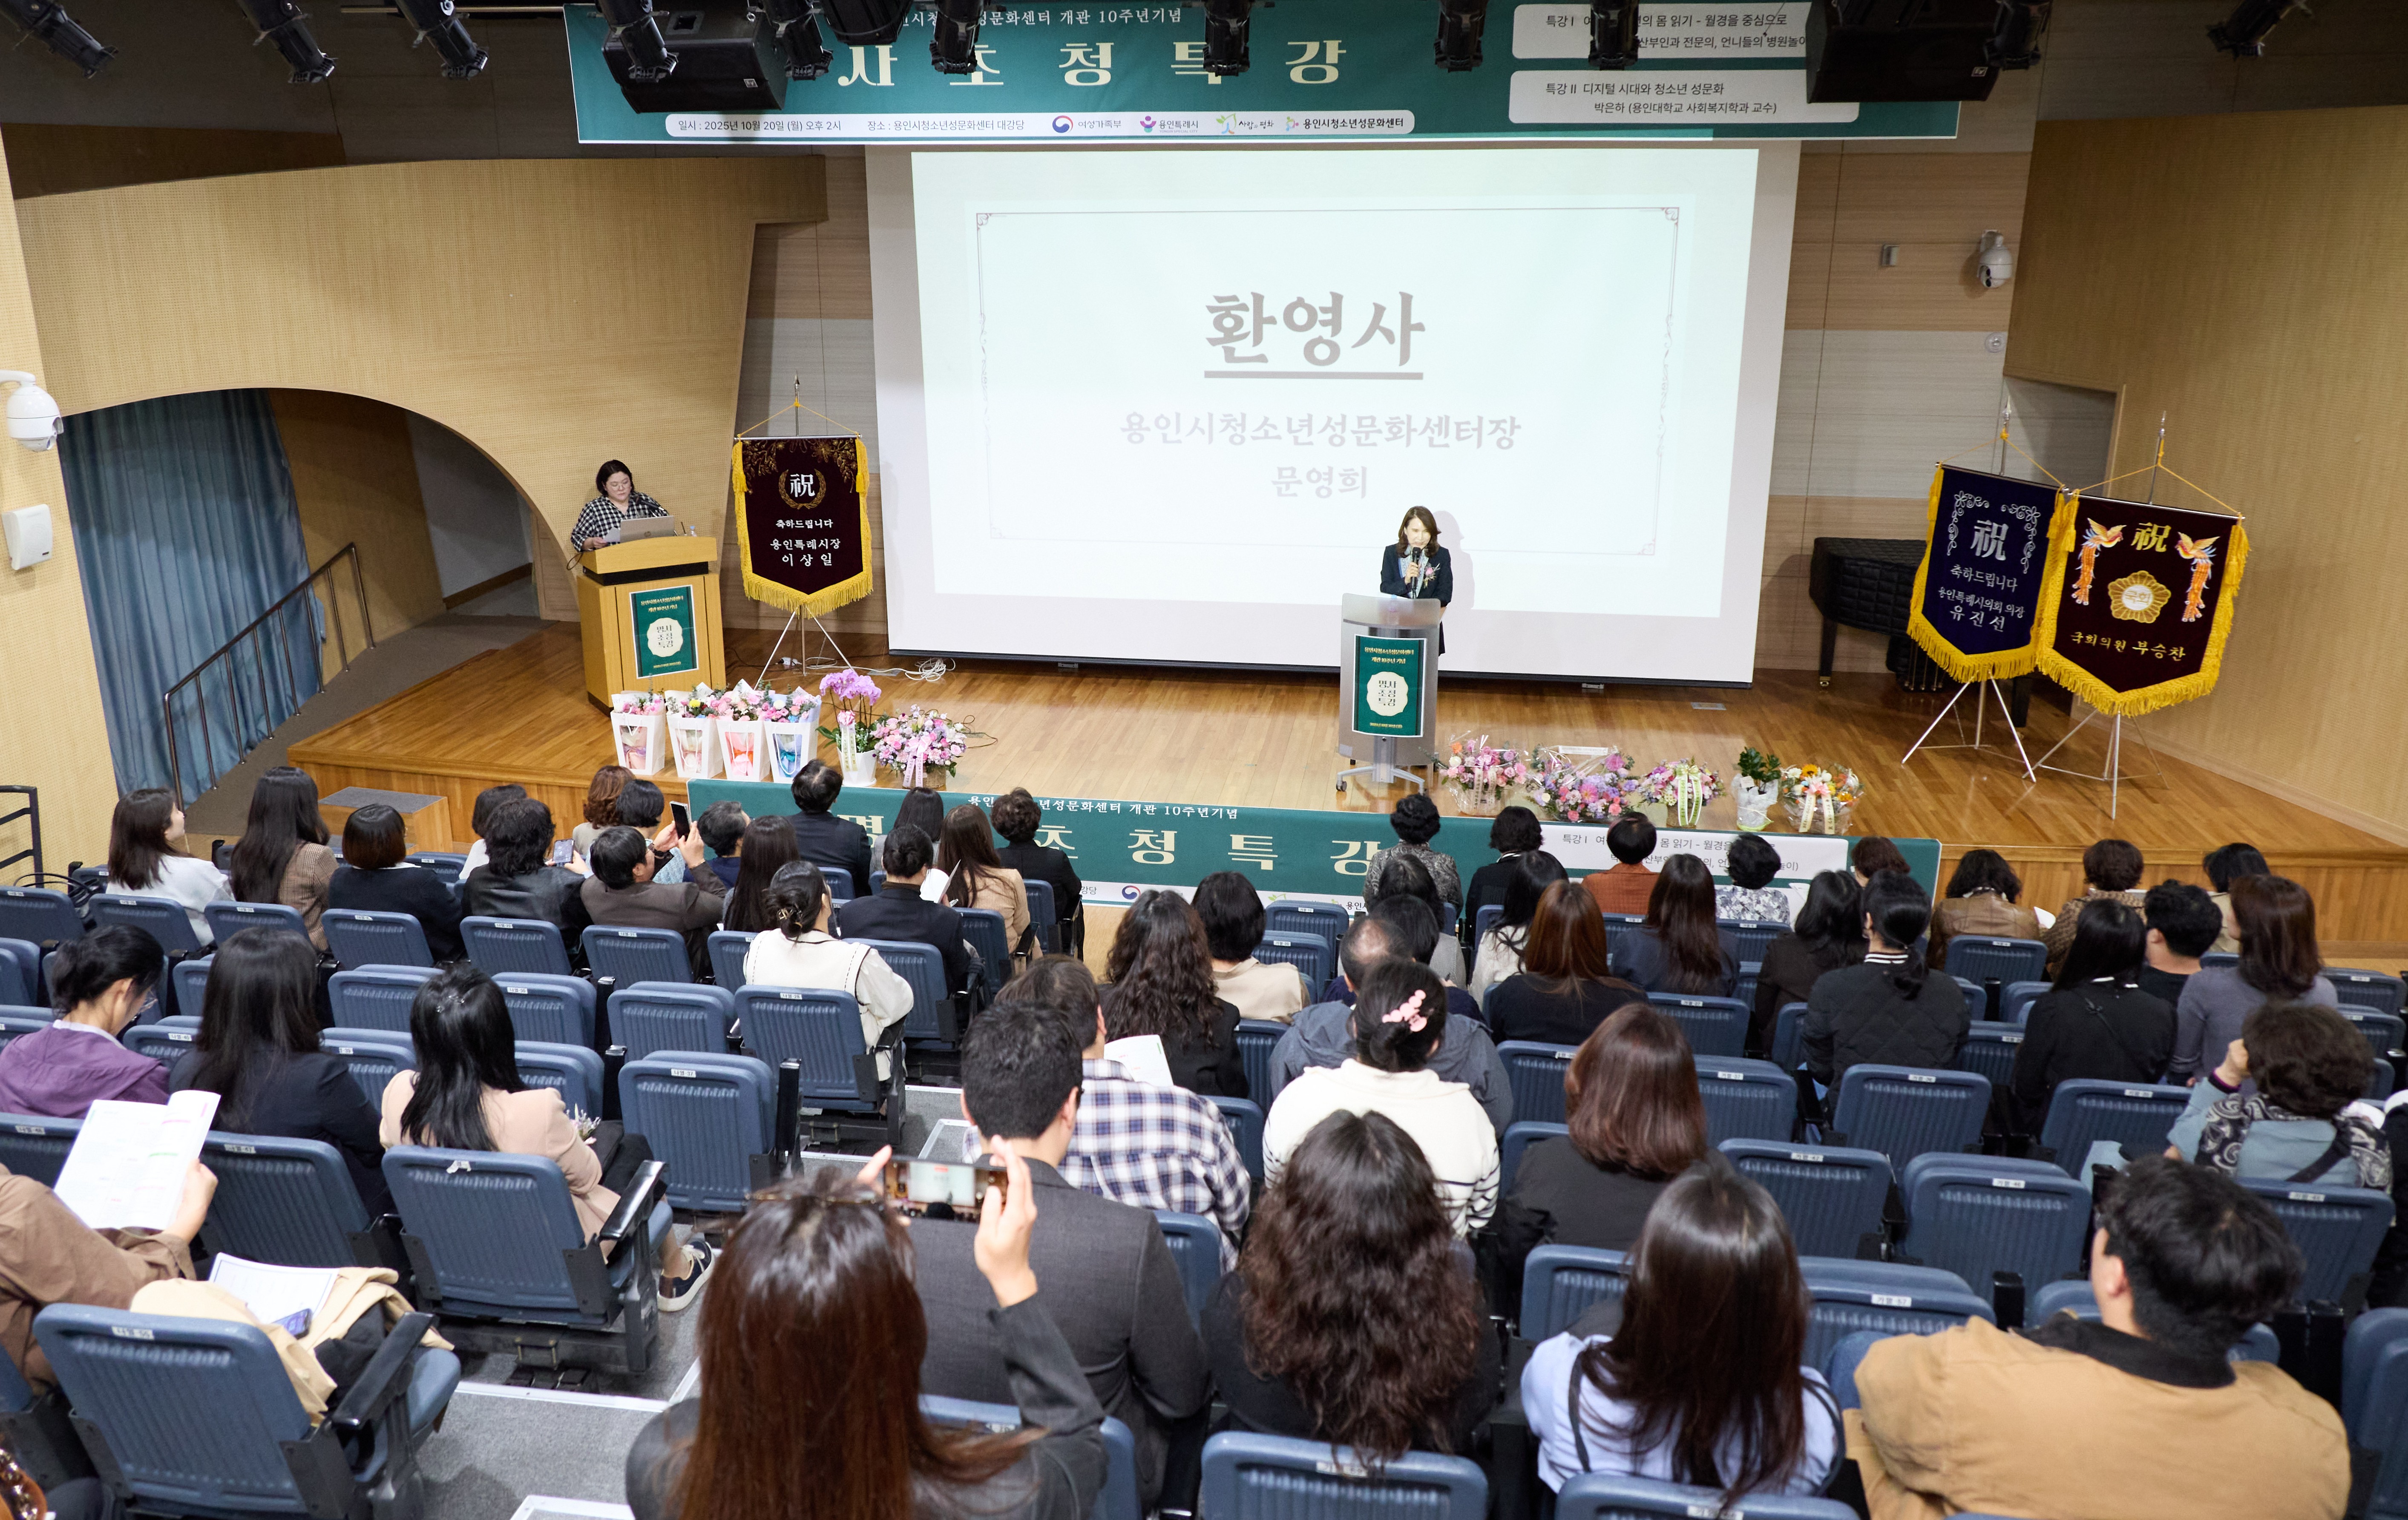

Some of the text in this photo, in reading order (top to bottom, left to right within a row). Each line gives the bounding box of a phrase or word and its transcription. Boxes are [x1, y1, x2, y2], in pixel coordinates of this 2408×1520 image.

[1060, 10, 1090, 25] 개관
[1099, 8, 1181, 23] 10주년기념
[1546, 15, 1567, 27] 특강
[1657, 15, 1667, 27] 몸
[1672, 15, 1692, 27] 읽기
[1705, 14, 1739, 27] 월경을
[1742, 14, 1787, 26] 중심으로
[1683, 37, 1717, 49] 전문의,
[1721, 37, 1763, 47] 언니들의
[1546, 83, 1567, 95] 특강
[1583, 83, 1615, 95] 디지털
[1619, 83, 1651, 95] 시대와
[1654, 83, 1686, 95] 청소년
[1691, 83, 1724, 95] 성문화
[1595, 103, 1777, 114] 박은하 (용인대학교 사회복지학과 교수)
[679, 121, 696, 130] 일시
[705, 121, 738, 130] 2025년
[741, 121, 760, 130] 10월
[764, 121, 784, 130] 20일
[787, 121, 803, 131] (월)
[806, 121, 823, 130] 오후
[826, 121, 841, 130] 2시
[867, 121, 886, 130] 장소
[894, 120, 994, 131] 용인시청소년성문화센터
[998, 120, 1024, 130] 대강당
[1078, 120, 1122, 129] 여성가족부
[1159, 120, 1198, 129] 용인특례시
[1303, 118, 1404, 129] 용인시청소년성문화센터
[1205, 291, 1426, 367] 환영사
[1120, 412, 1522, 450] 용인시청소년성문화센터장
[790, 473, 815, 498] 祝
[1272, 465, 1368, 499] 문영희
[775, 518, 833, 529] 축하드립니다
[1970, 520, 2009, 561] 祝
[2131, 522, 2172, 553] 祝
[770, 538, 841, 550] 용인특례시장
[1950, 564, 2018, 593] 축하드립니다
[1938, 587, 2025, 619] 용인특례시의회 의장
[2071, 631, 2186, 661] 국회의원 부승찬
[1378, 680, 1397, 688] 명사
[1378, 698, 1396, 706] 특강
[1130, 803, 1157, 815] 개관
[1165, 806, 1237, 819] 10주년기념
[1562, 834, 1582, 844] 특강
[1660, 838, 1669, 848] 몸
[1673, 839, 1692, 849] 읽기
[1703, 840, 1732, 851] 월경을
